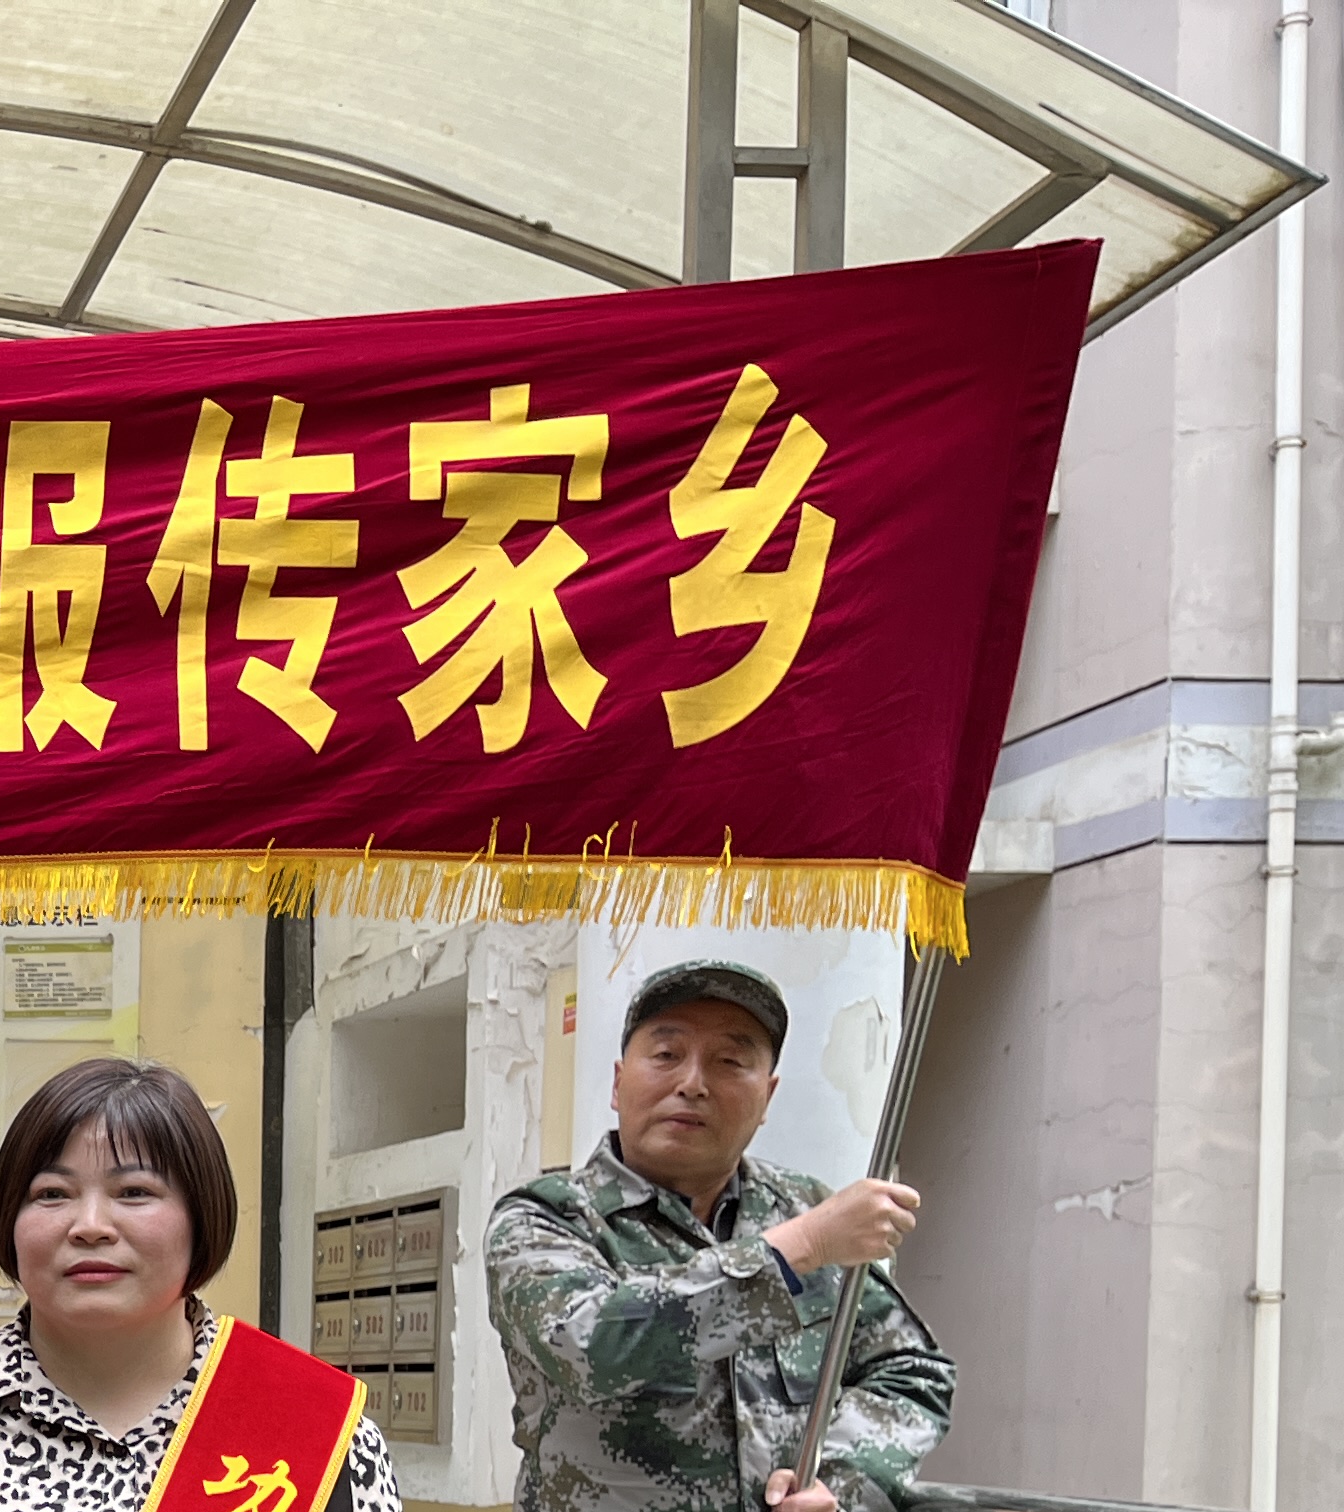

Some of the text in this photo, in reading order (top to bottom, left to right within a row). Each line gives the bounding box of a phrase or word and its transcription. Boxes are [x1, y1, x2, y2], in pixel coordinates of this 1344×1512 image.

[327, 1244, 345, 1265] 302
[326, 1318, 343, 1338] 202
[365, 1314, 384, 1335] 502
[407, 1391, 426, 1412] 702
